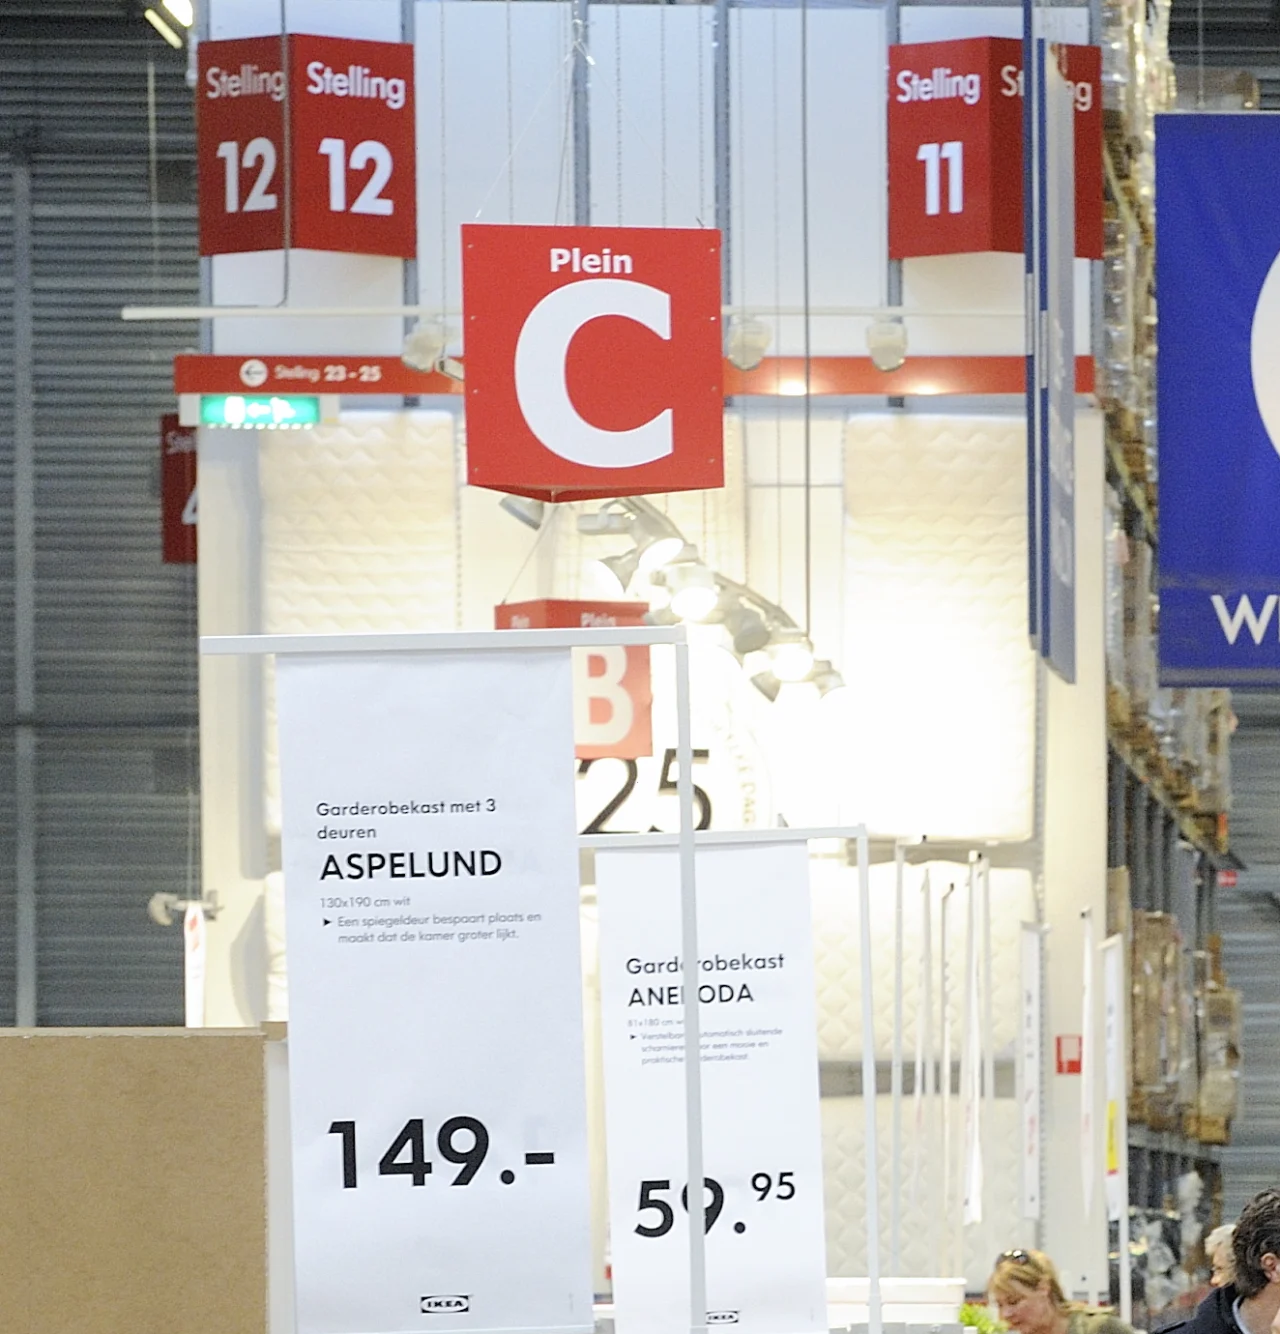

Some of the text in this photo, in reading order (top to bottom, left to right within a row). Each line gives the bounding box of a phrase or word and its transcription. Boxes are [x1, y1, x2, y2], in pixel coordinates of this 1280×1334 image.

[206, 66, 286, 100] Stelling
[306, 61, 406, 110] Stelling
[896, 68, 981, 105] Stelling
[216, 138, 278, 213] 12
[317, 137, 395, 216] 12
[916, 141, 963, 216] 11
[549, 248, 634, 276] Plein
[514, 279, 673, 468] C
[571, 645, 633, 746] B
[316, 798, 497, 817] Garderobekast met 3
[577, 748, 713, 835] 25
[317, 825, 377, 840] deuren
[319, 850, 502, 881] ASPELUND
[320, 896, 411, 909] 130x190 cm wit
[337, 911, 542, 929] Een spiegeldeur bespaart plaats en
[338, 933, 374, 944] maakt
[377, 931, 398, 943] dat
[400, 930, 416, 942] de
[418, 929, 455, 942] kamer
[457, 930, 493, 943] groter
[626, 953, 785, 975] Gardobekast
[628, 983, 754, 1007] ANEODA
[327, 1115, 556, 1188] 149.-
[634, 1172, 796, 1238] 59.95
